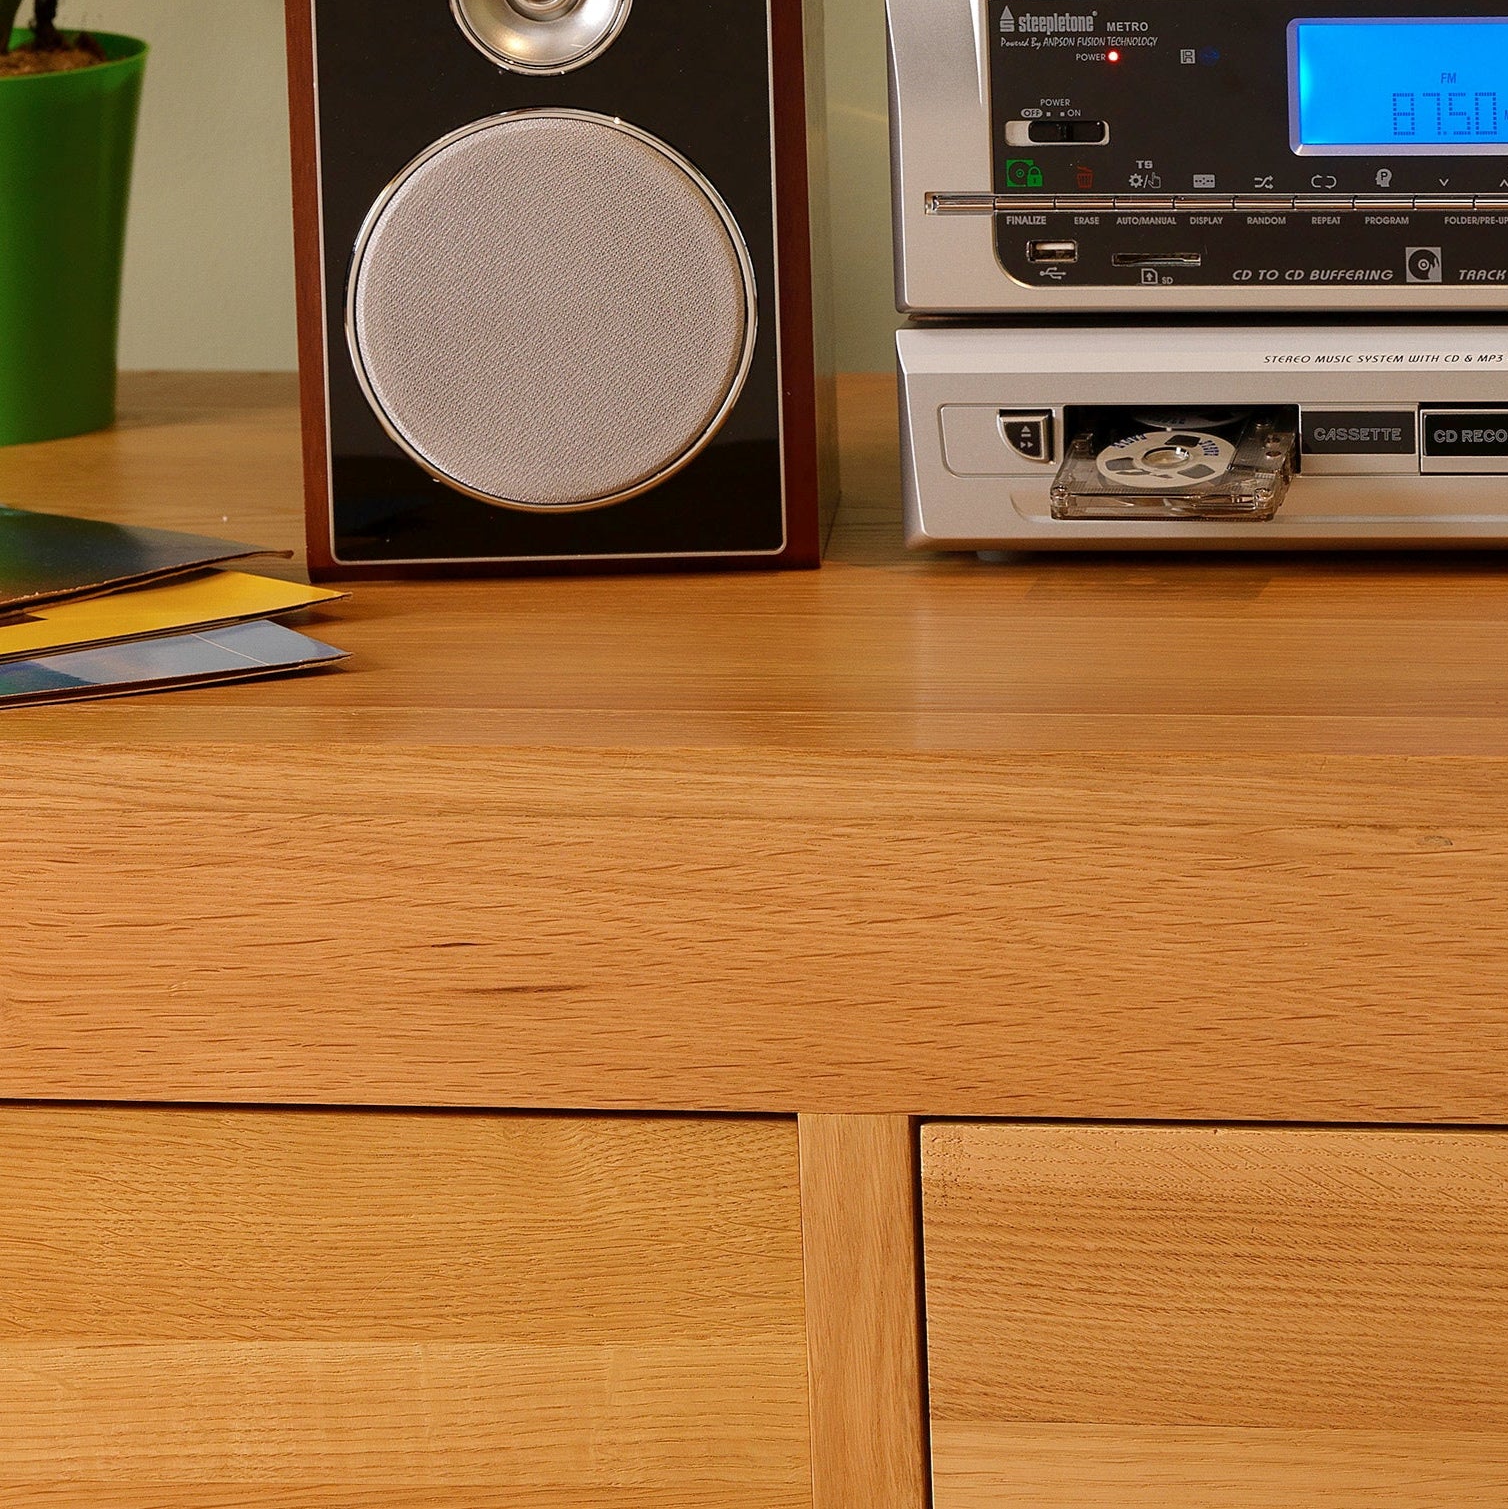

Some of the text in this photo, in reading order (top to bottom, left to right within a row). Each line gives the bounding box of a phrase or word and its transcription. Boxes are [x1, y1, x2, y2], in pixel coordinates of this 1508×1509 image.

[1107, 22, 1148, 31] METRO
[1001, 37, 1158, 50] Powered By ANPSON FUSION TECHNOLOGY
[1076, 53, 1106, 61] POWER
[1440, 73, 1457, 84] FM
[1040, 98, 1070, 106] POWER
[1024, 109, 1041, 117] OFF
[1067, 109, 1081, 117] ON
[1006, 216, 1046, 225] FINALIZE
[1074, 217, 1100, 225] ERASE
[1116, 216, 1177, 226] AUTO/MANUAL
[1190, 216, 1223, 225] DISPLAY
[1246, 217, 1286, 225] RANDOM
[1311, 216, 1341, 224] REPEAT
[1365, 216, 1409, 225] PROGRAM
[1232, 270, 1394, 281] CD TO CD BUFFERING
[1459, 270, 1506, 280] TRACK
[1162, 276, 1173, 284] SD
[1315, 355, 1353, 363] MUSIC
[1357, 355, 1404, 363] SYSTEM
[1313, 427, 1402, 441] CASSETTE
[1434, 430, 1458, 443] CD
